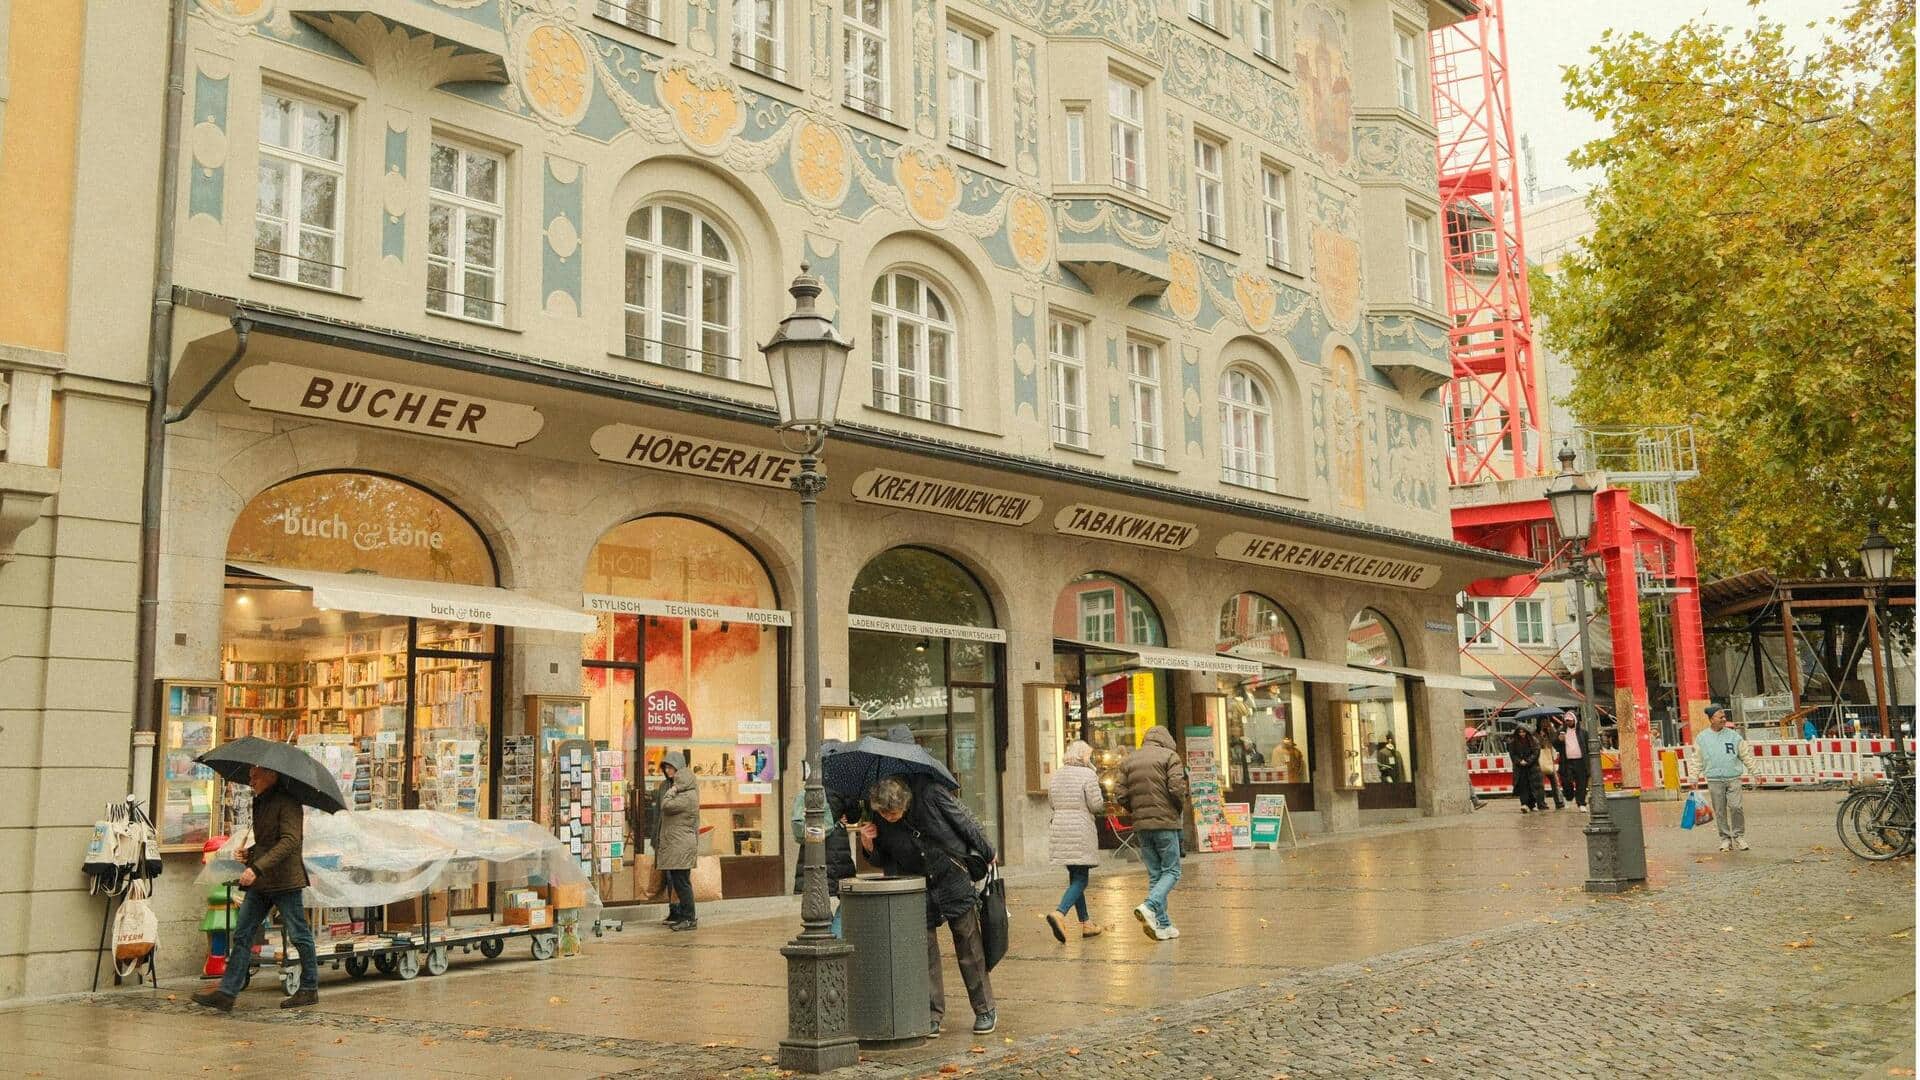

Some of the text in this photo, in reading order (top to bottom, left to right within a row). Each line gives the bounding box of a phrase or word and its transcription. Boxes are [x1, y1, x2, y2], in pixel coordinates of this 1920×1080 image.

[300, 376, 487, 434] BÜCHER
[626, 433, 796, 483] HÖRGERÄTE
[868, 474, 1031, 520] KREATIVMUENCHEN
[284, 507, 443, 550] buch & töne
[1068, 508, 1192, 546] TABAKWAREN
[1243, 538, 1424, 583] HERRENBEKLEIDUNG
[430, 602, 492, 620] buch & töne
[591, 598, 785, 624] STYLISCH TECHNISCH MODERN
[851, 618, 875, 628] LADEN
[891, 623, 917, 633] KULTUR
[920, 626, 933, 634] UND
[648, 695, 677, 711] Sale
[648, 712, 686, 725] bis 50%
[1725, 742, 1736, 754] R
